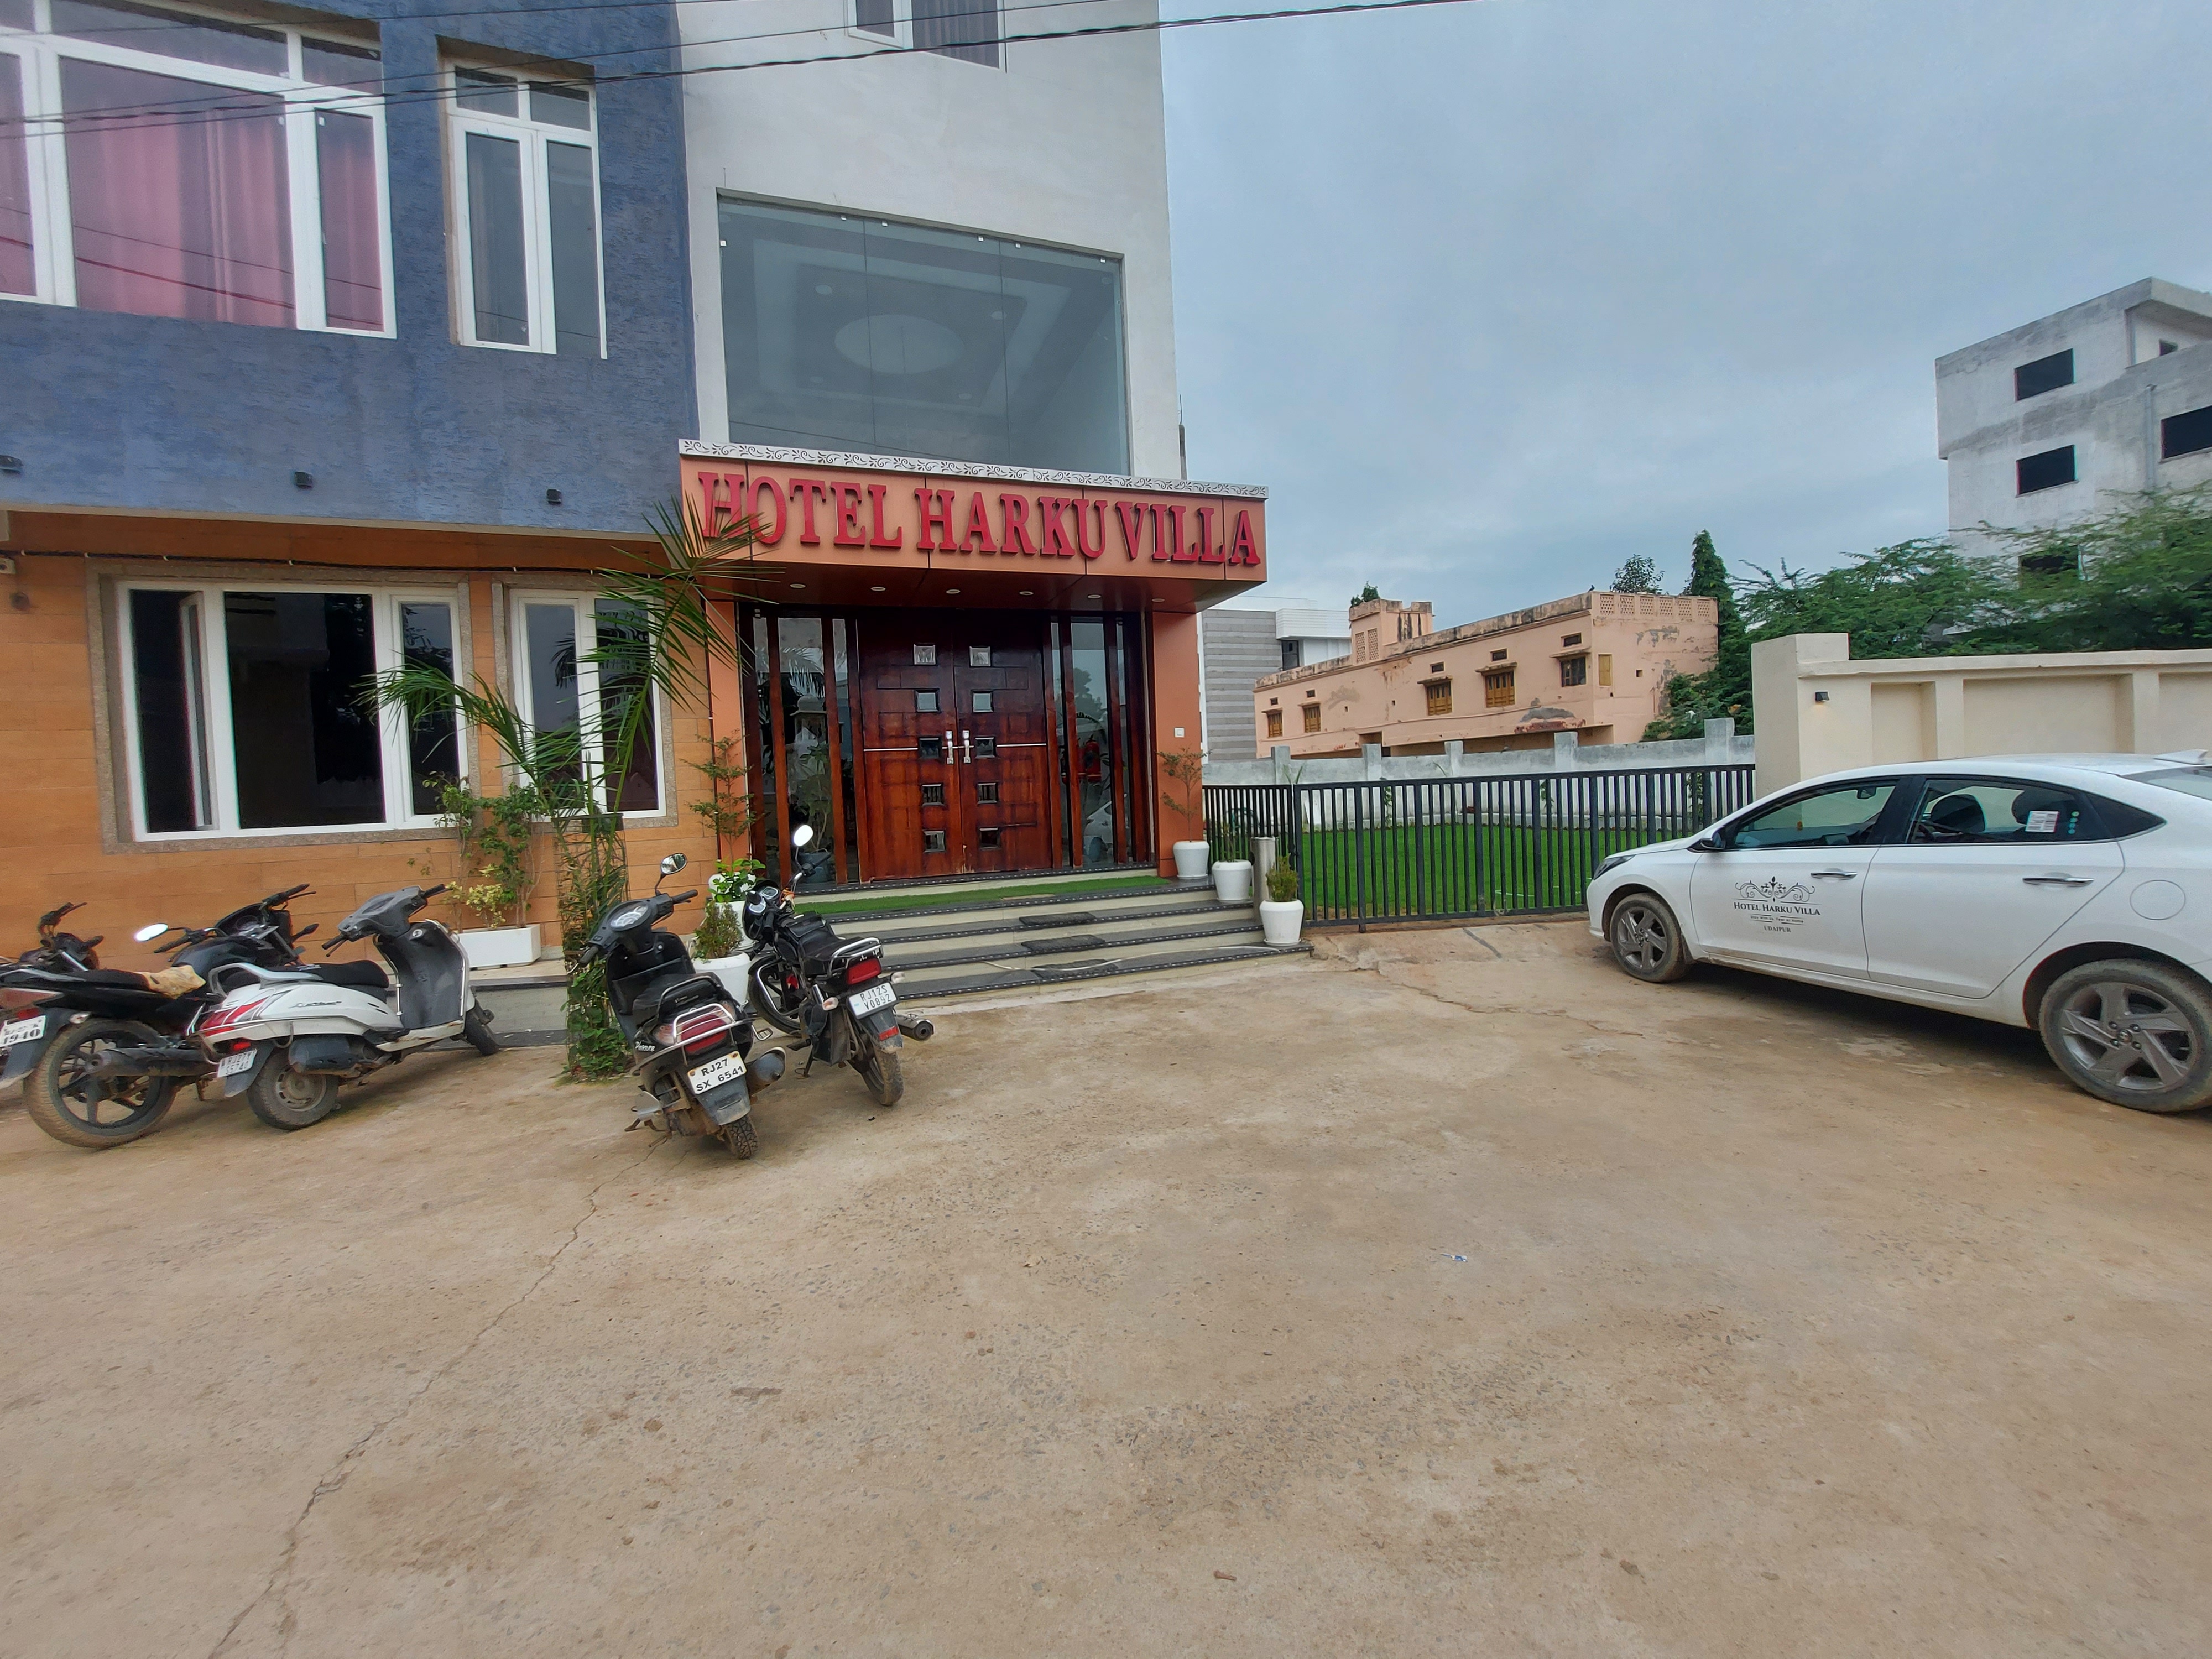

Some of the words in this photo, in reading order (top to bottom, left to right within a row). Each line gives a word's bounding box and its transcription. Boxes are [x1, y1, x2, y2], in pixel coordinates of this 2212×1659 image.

[697, 471, 902, 549] HOTEL
[915, 488, 1108, 559] HARKU
[1115, 500, 1261, 566] VILLA
[1734, 901, 1761, 911] HOTEL
[1762, 904, 1792, 914] HARKU
[1794, 906, 1821, 916] VILLA
[860, 985, 888, 1001] RJ12S
[864, 994, 891, 1010] V0892
[701, 1058, 728, 1076] RJ27
[696, 1079, 712, 1092] SX
[717, 1065, 744, 1082] 6541
